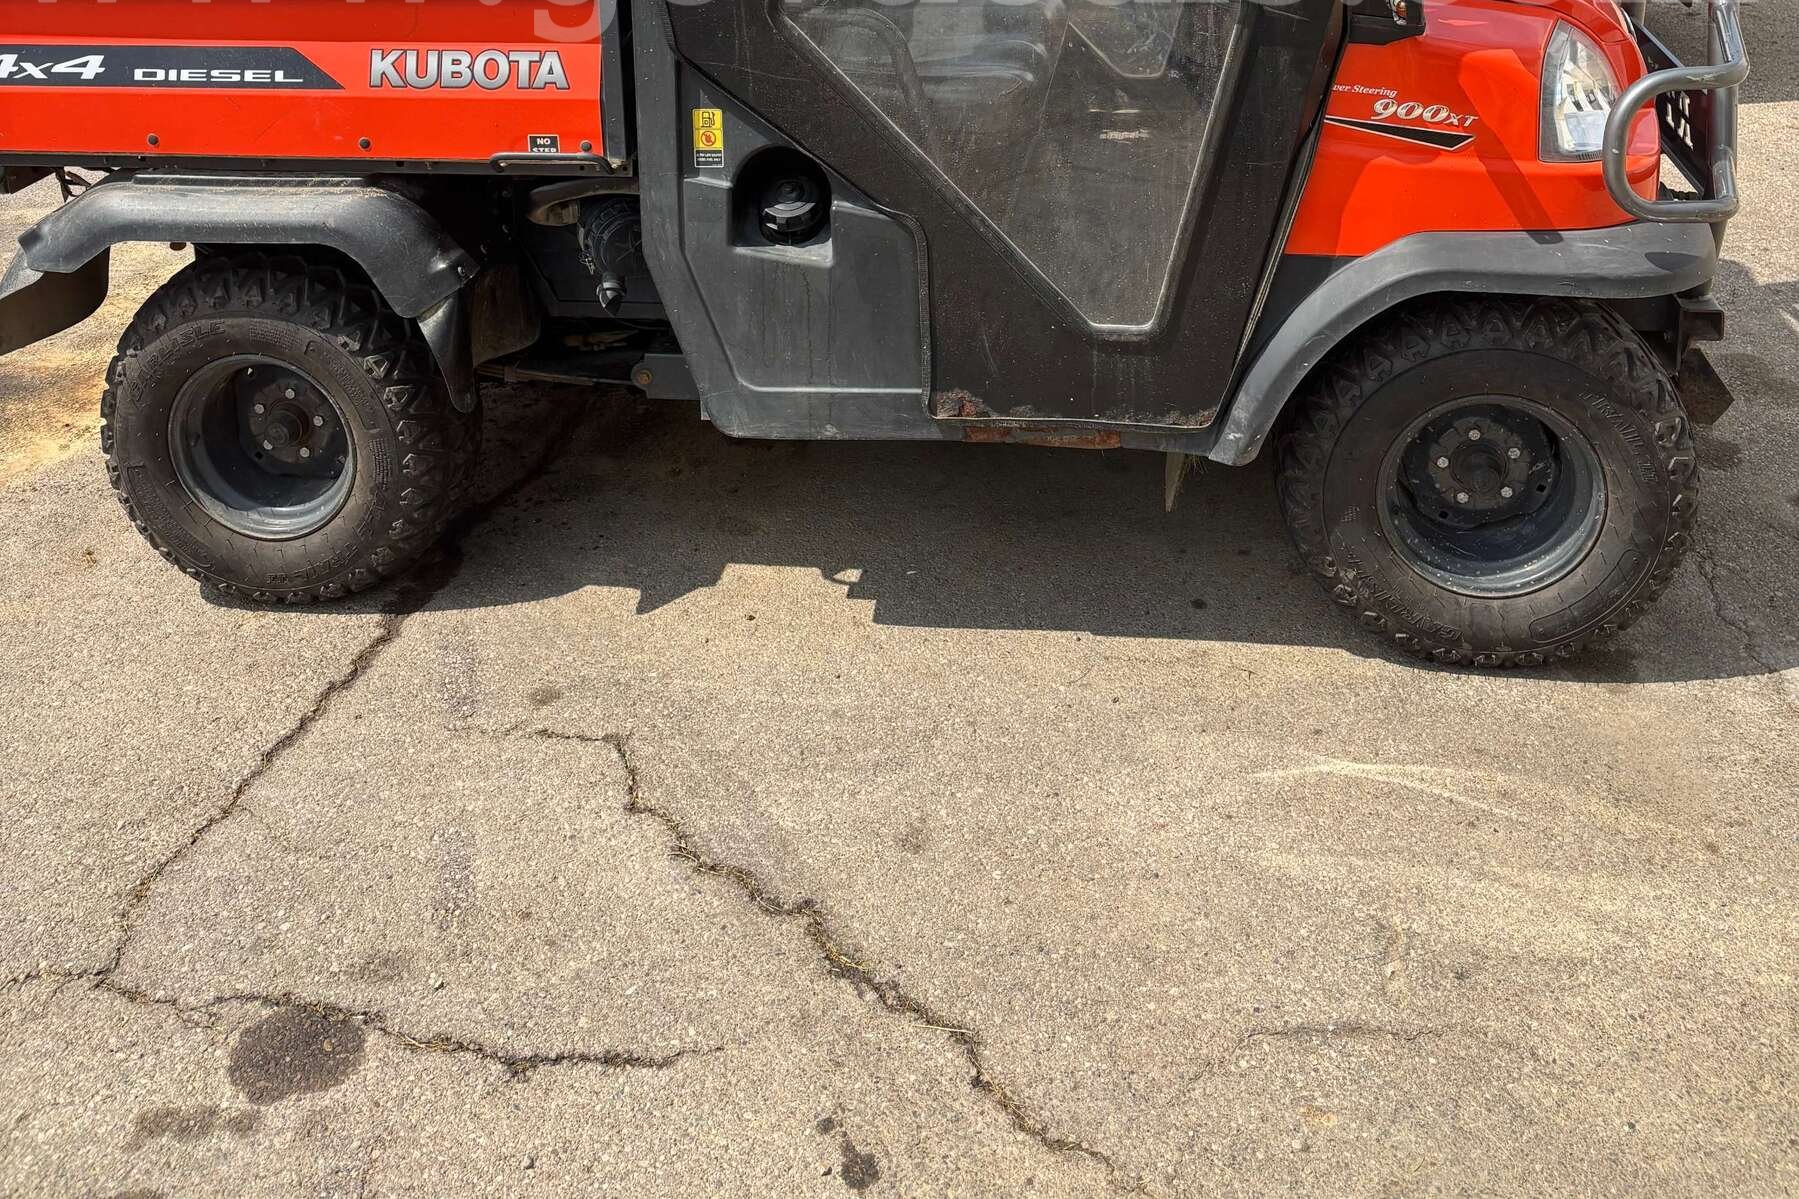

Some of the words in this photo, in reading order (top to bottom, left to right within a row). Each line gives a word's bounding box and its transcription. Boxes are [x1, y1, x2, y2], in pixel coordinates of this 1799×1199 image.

[133, 68, 304, 83] DIESEL
[369, 48, 571, 91] KUBOTA
[1352, 84, 1398, 99] Steering
[536, 137, 551, 145] NO
